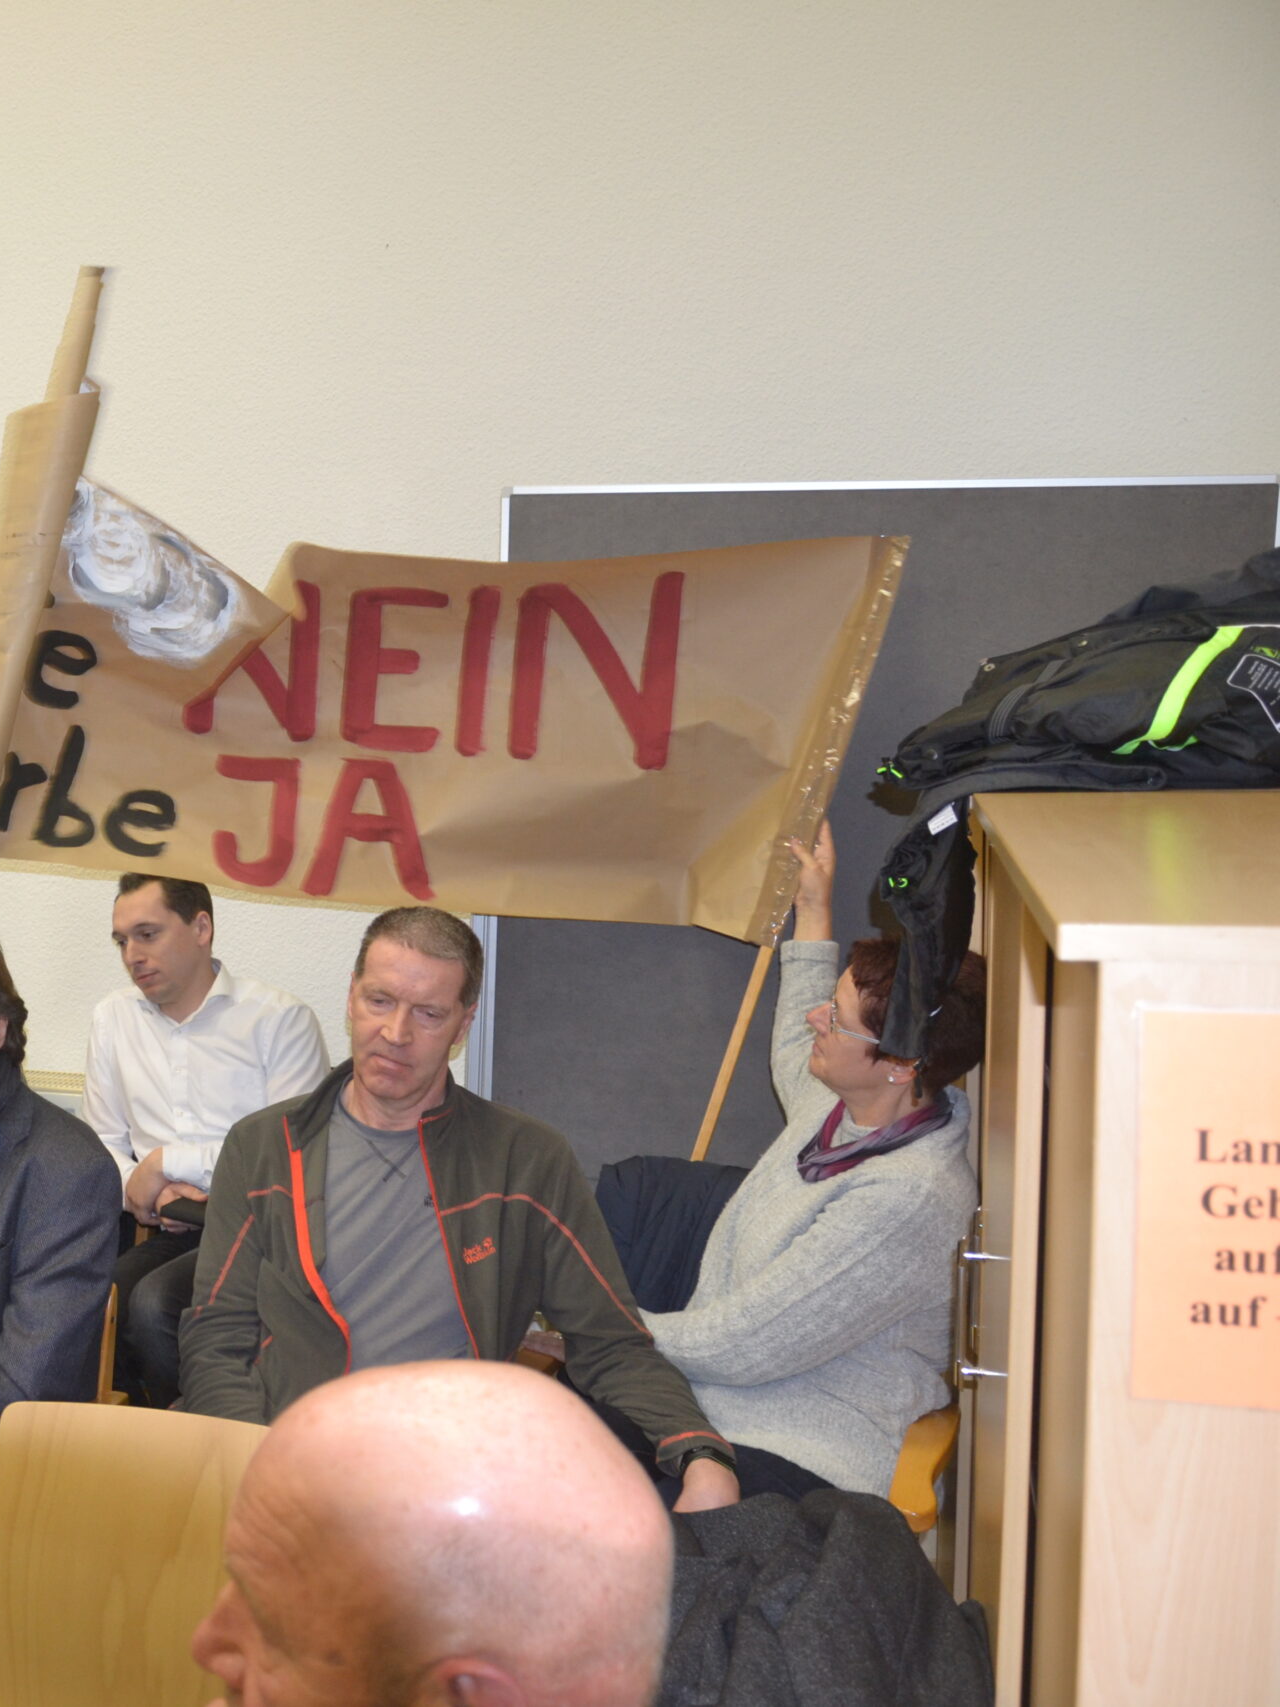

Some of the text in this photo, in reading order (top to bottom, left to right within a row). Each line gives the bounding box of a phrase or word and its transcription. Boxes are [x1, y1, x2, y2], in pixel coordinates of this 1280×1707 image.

[182, 571, 685, 771] NEIN
[213, 754, 437, 900] JA
[1190, 1295, 1268, 1328] auf
